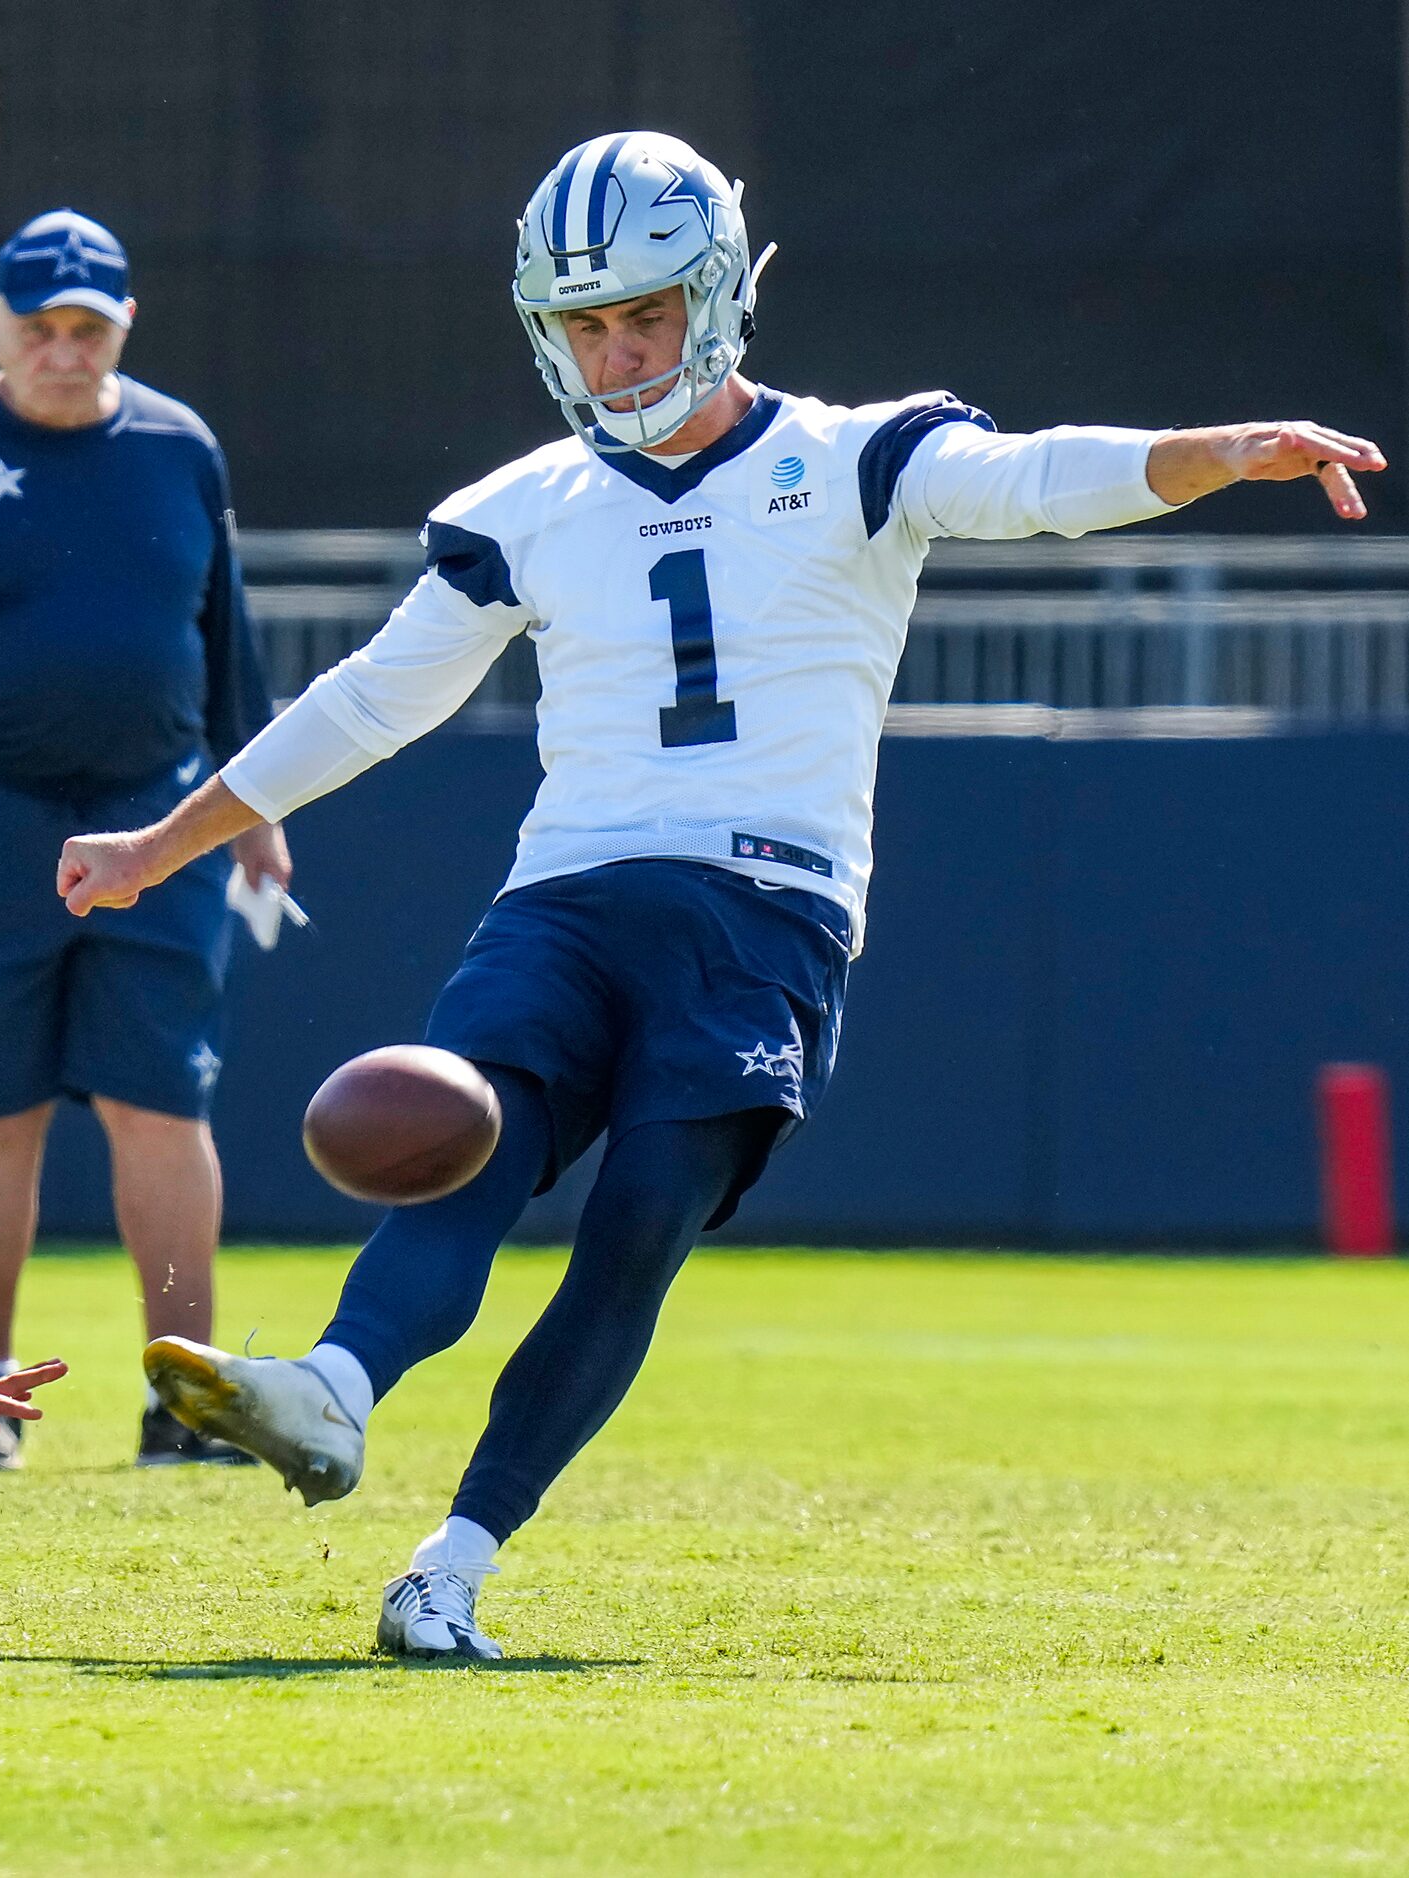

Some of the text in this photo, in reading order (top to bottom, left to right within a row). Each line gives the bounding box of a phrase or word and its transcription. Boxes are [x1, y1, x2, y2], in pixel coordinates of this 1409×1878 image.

[558, 280, 601, 295] COWBOYS
[767, 491, 812, 514] AT&T
[639, 515, 713, 538] COWBOYS
[648, 548, 738, 748] 1
